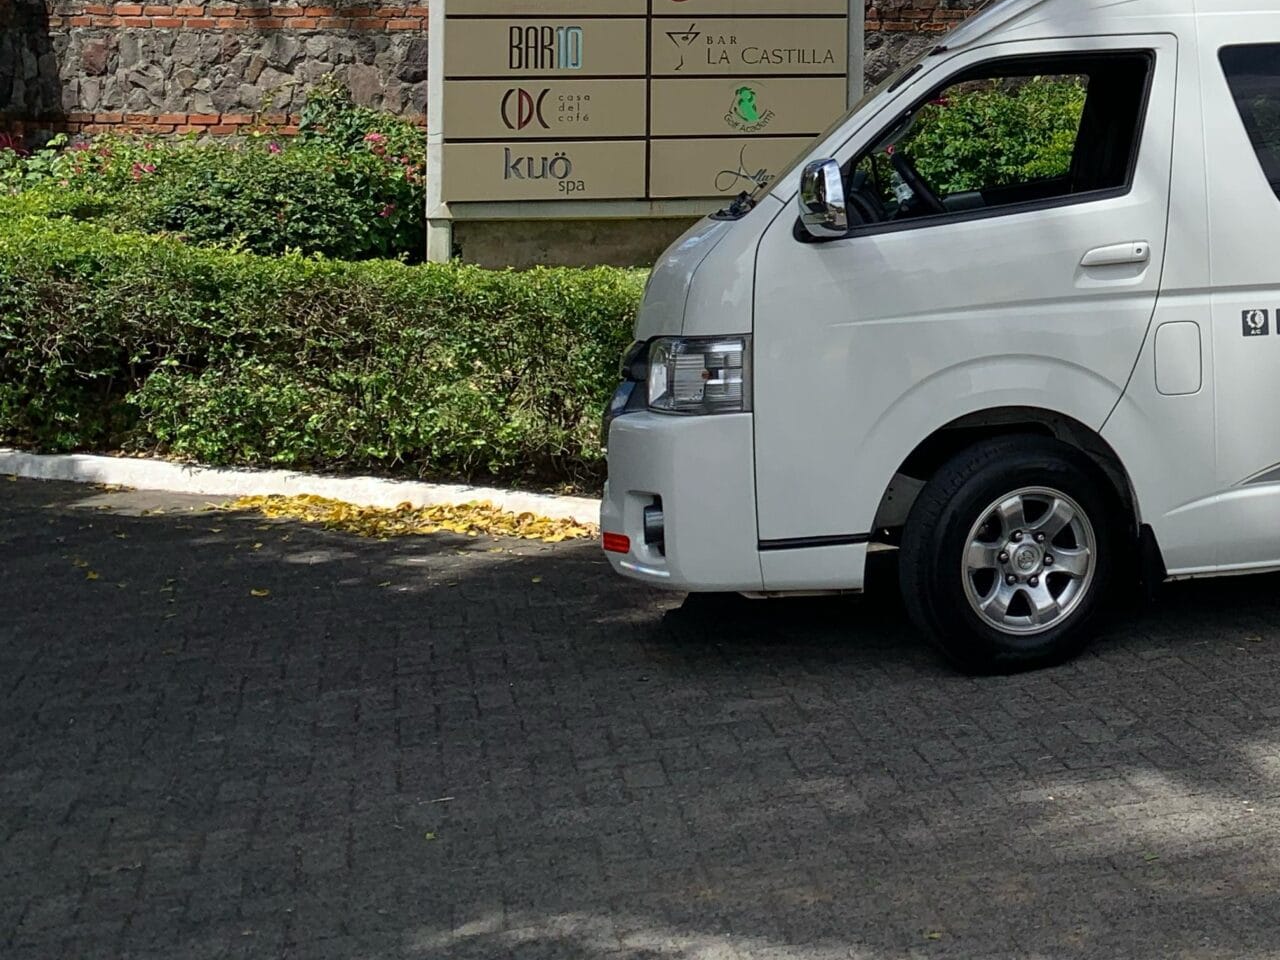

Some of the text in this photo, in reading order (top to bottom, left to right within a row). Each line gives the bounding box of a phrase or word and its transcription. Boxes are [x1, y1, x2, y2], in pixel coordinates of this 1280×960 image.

[706, 35, 738, 45] BAR
[707, 47, 835, 65] LA CASTILLA
[558, 94, 591, 102] casa
[558, 103, 580, 112] del
[558, 112, 590, 122] café
[504, 147, 573, 180] kuö
[558, 180, 586, 196] spa
